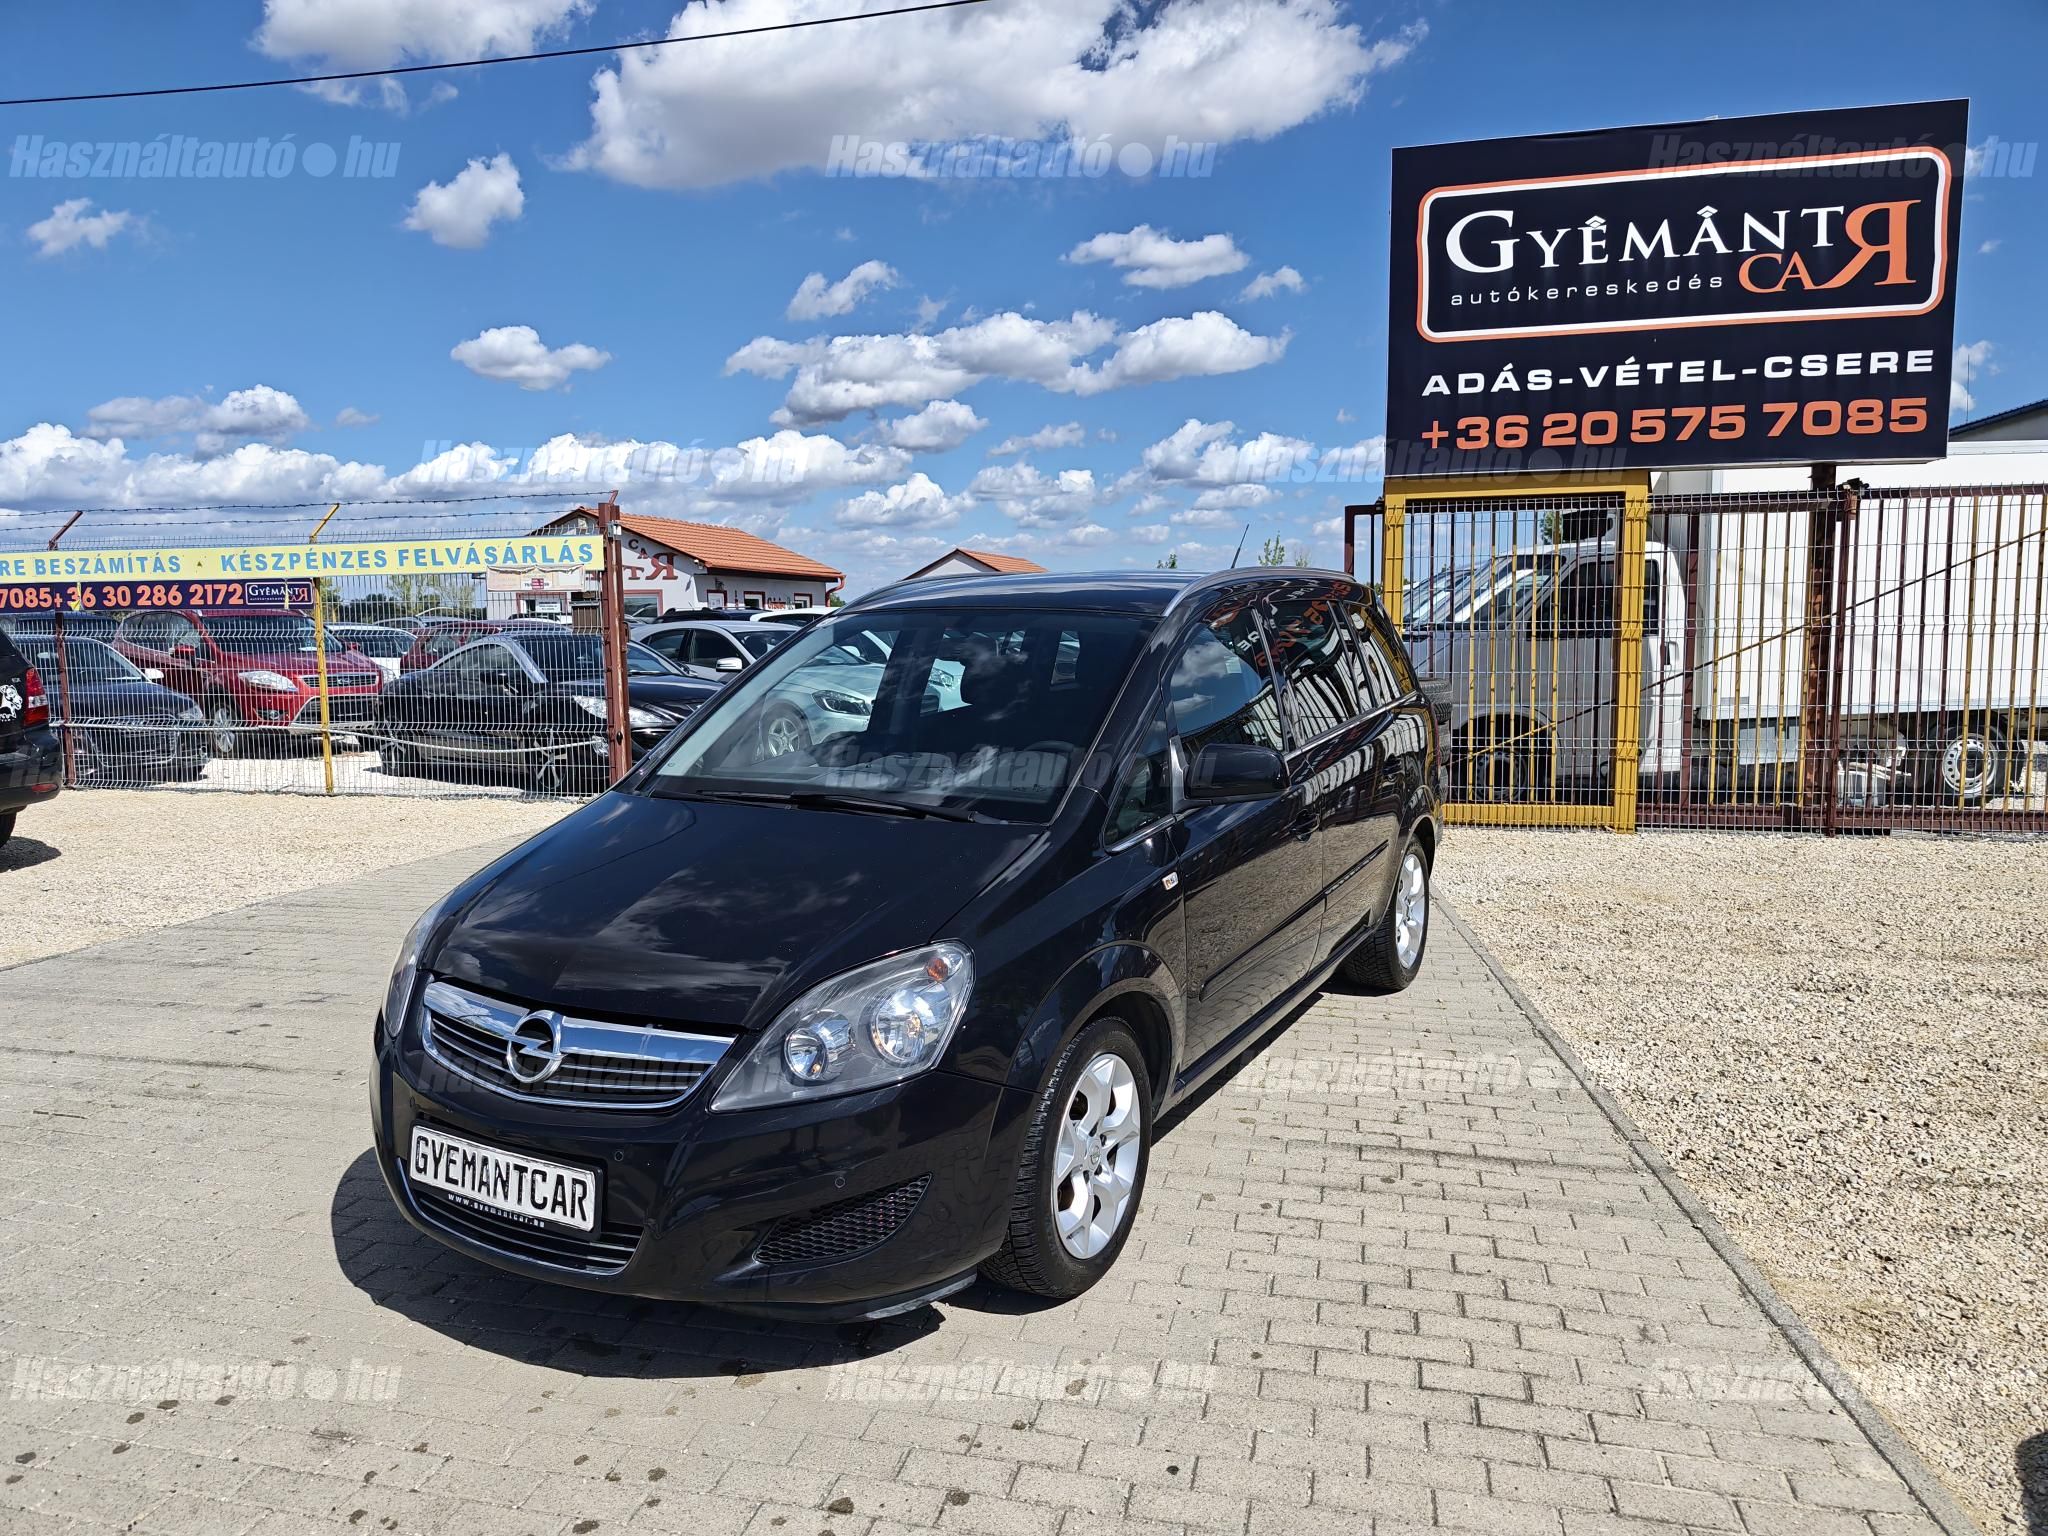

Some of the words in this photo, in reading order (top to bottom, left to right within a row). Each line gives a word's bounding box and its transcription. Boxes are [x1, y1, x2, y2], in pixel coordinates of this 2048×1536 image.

[1451, 274, 1722, 305] autókereskedés
[1421, 350, 1934, 397] ADÁS-VÉTEL-CSERE
[1421, 414, 1529, 450] +36
[1542, 411, 1618, 447] 20
[1630, 404, 1746, 443] 575
[1762, 397, 1928, 437] 7085
[34, 551, 181, 576] BESZÁMÍTÁS
[220, 548, 387, 572] KÉSZPÉNZES
[398, 540, 593, 567] FELVÁSÁRLÁS
[102, 585, 131, 607] 30
[136, 583, 182, 607] 286
[189, 582, 244, 606] 2172
[415, 1135, 588, 1222] GYEMANTCAR
